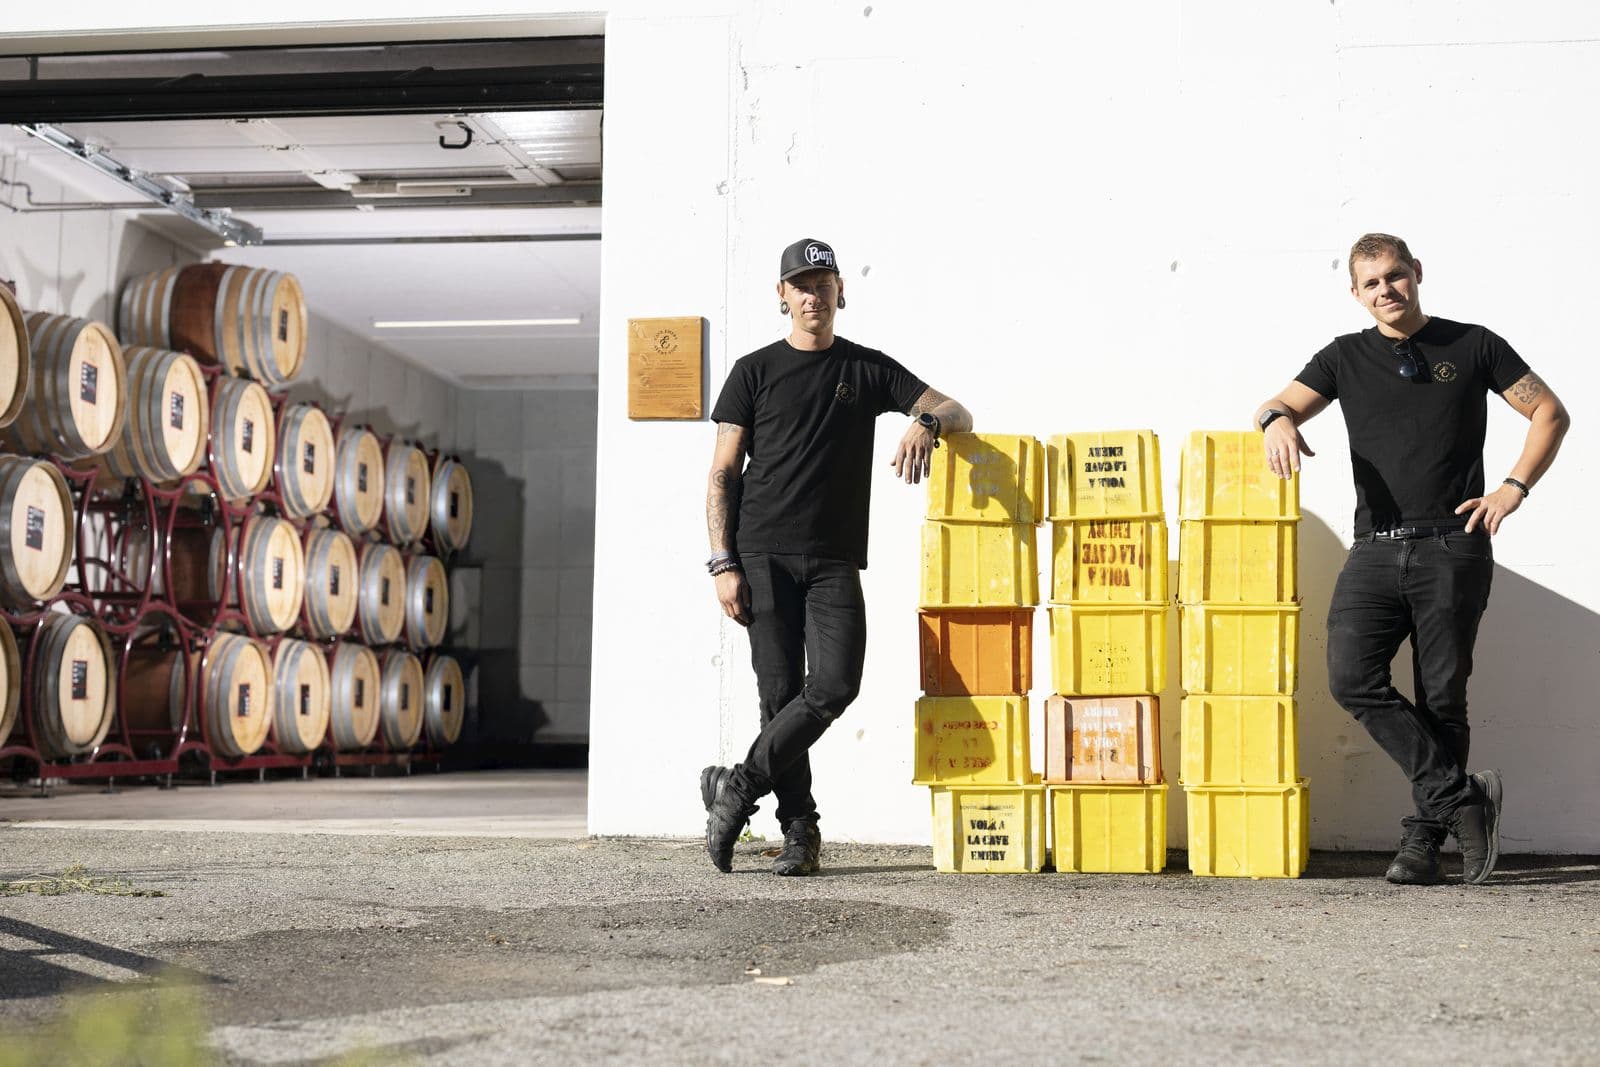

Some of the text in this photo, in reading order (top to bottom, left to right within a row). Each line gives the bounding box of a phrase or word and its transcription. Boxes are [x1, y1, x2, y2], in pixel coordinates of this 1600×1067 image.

[809, 246, 833, 266] Buff
[1088, 447, 1124, 457] EMERY
[1085, 461, 1127, 472] LA CAVE
[1082, 543, 1136, 565] LA CAVE
[967, 835, 1009, 846] LA CAVE
[970, 850, 1006, 861] EMERY
